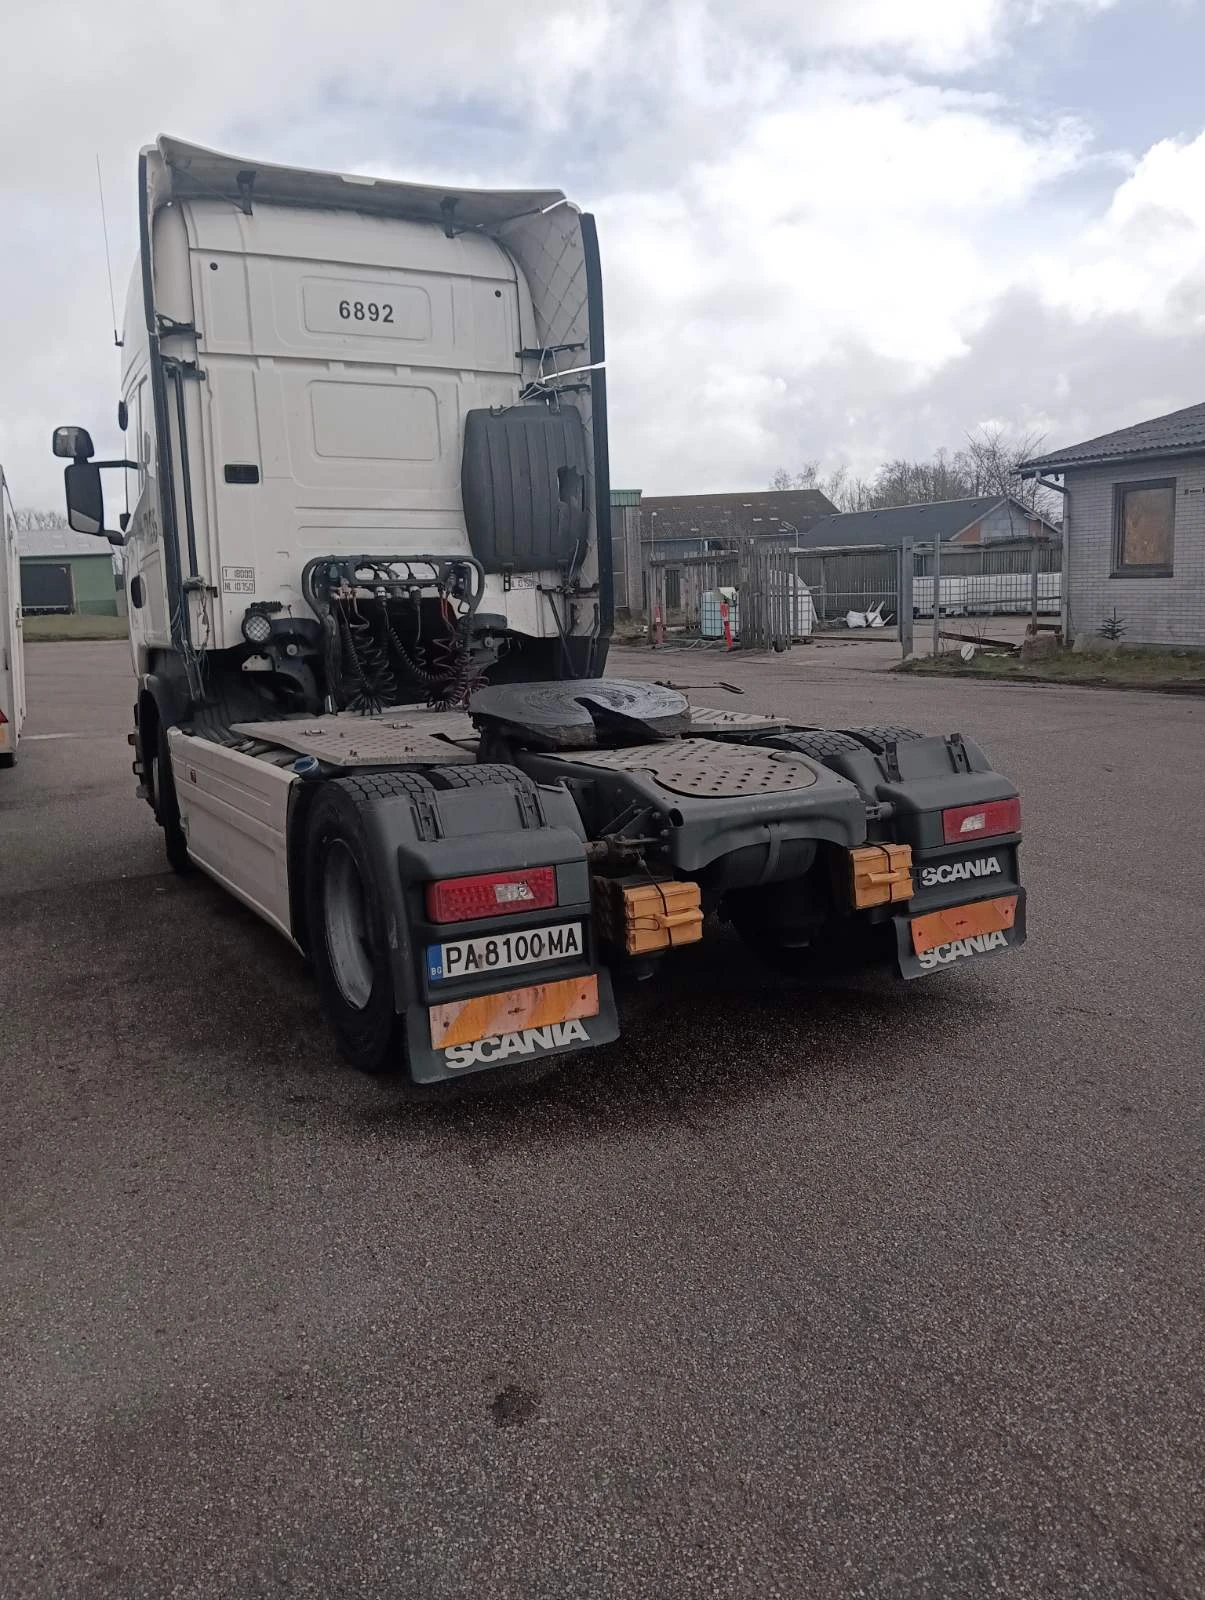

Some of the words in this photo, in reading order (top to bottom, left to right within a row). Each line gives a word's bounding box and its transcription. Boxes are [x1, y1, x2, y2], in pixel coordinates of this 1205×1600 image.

[339, 300, 394, 323] 6892
[922, 857, 1001, 886] SCANIA
[548, 928, 578, 955] MA
[919, 930, 1009, 969] SCANIA
[445, 1018, 591, 1069] SCANIA
